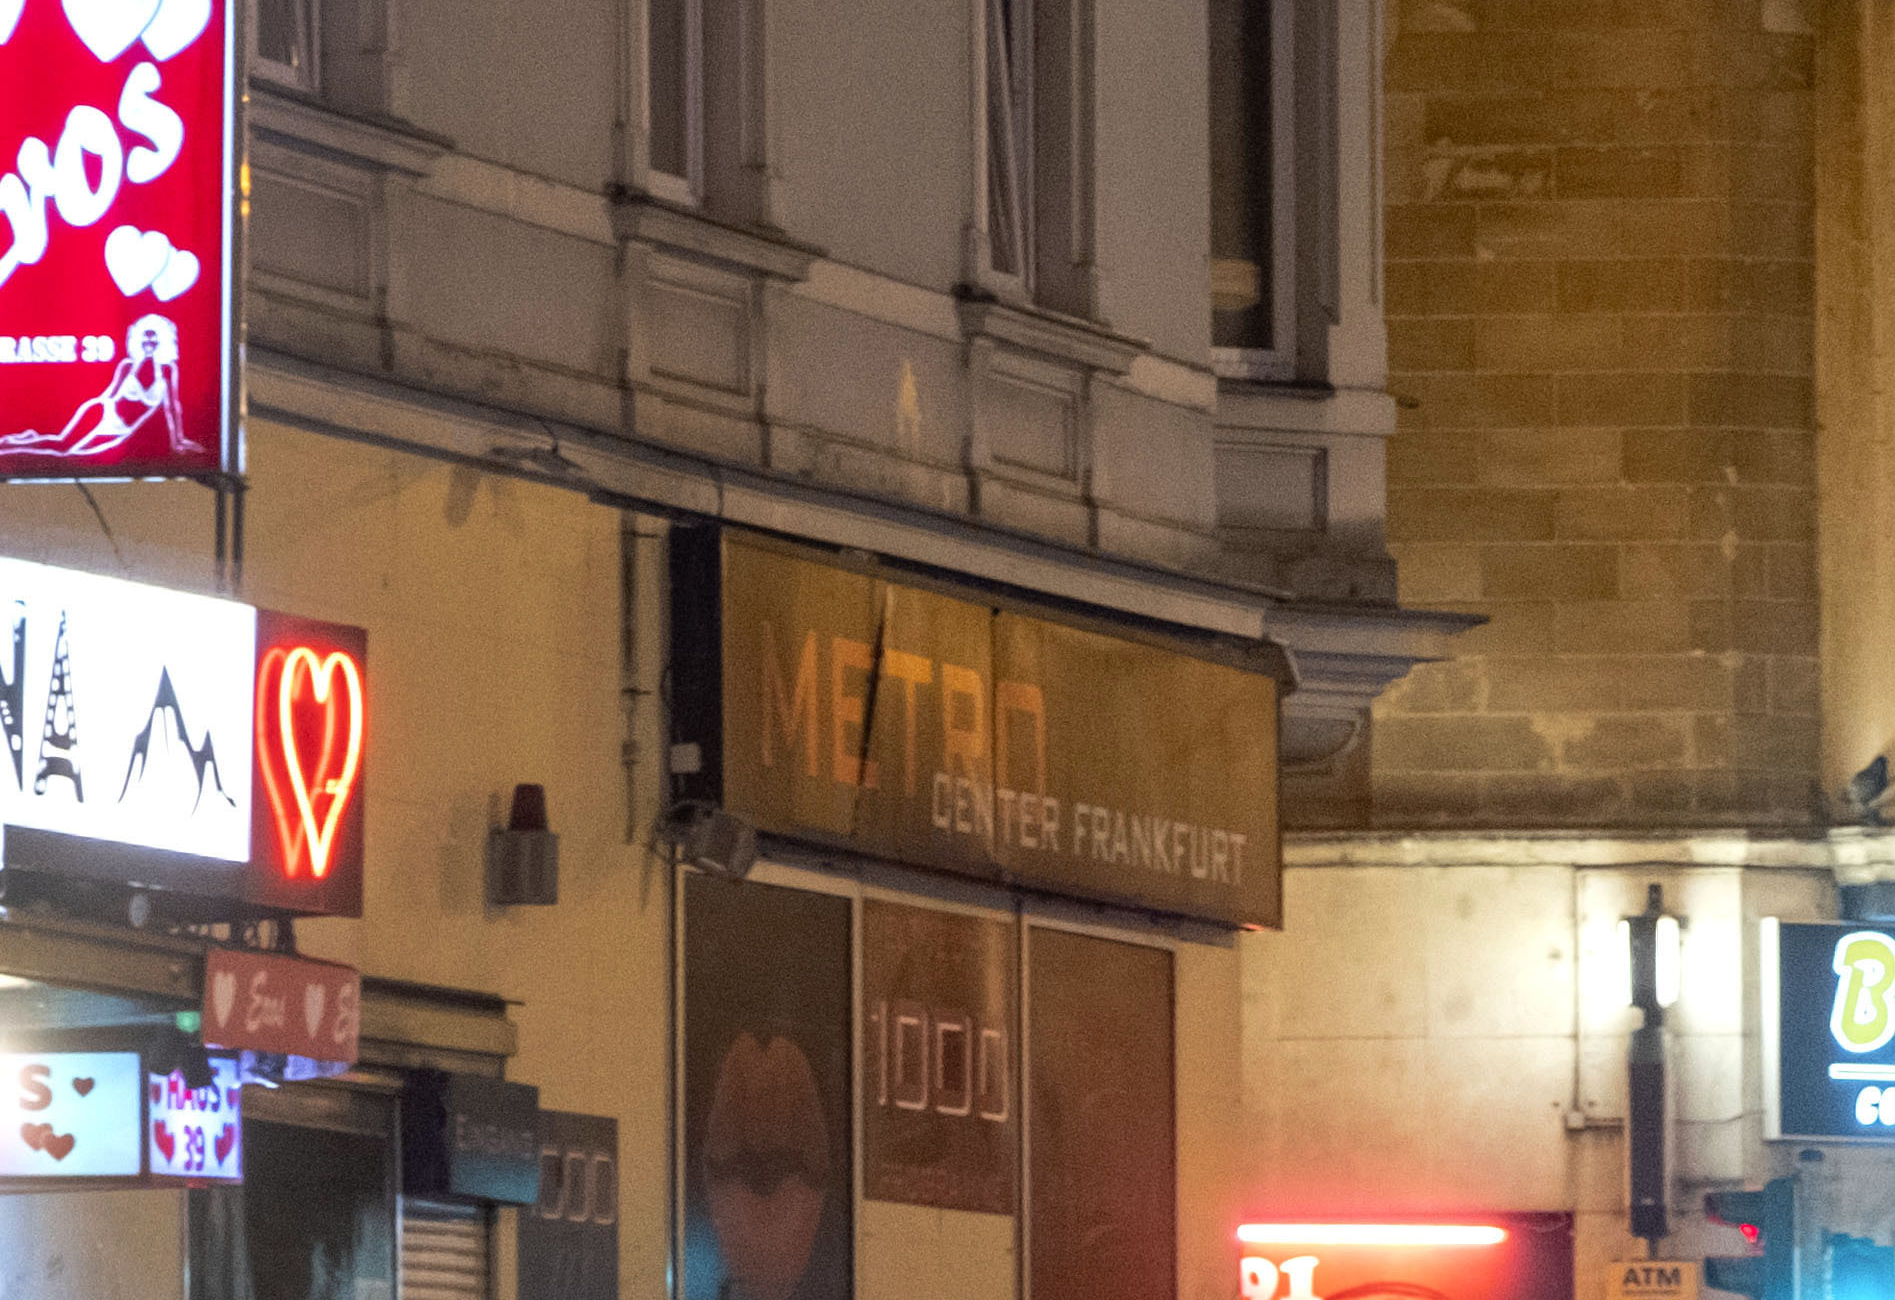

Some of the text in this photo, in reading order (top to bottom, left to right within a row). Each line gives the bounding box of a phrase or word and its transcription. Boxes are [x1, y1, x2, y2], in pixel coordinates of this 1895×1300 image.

[82, 334, 116, 364] 39
[760, 620, 1047, 805] METRO
[932, 773, 1247, 884] CENTER FRANKFURT
[183, 1124, 206, 1172] 39
[1622, 1267, 1682, 1287] ATM
